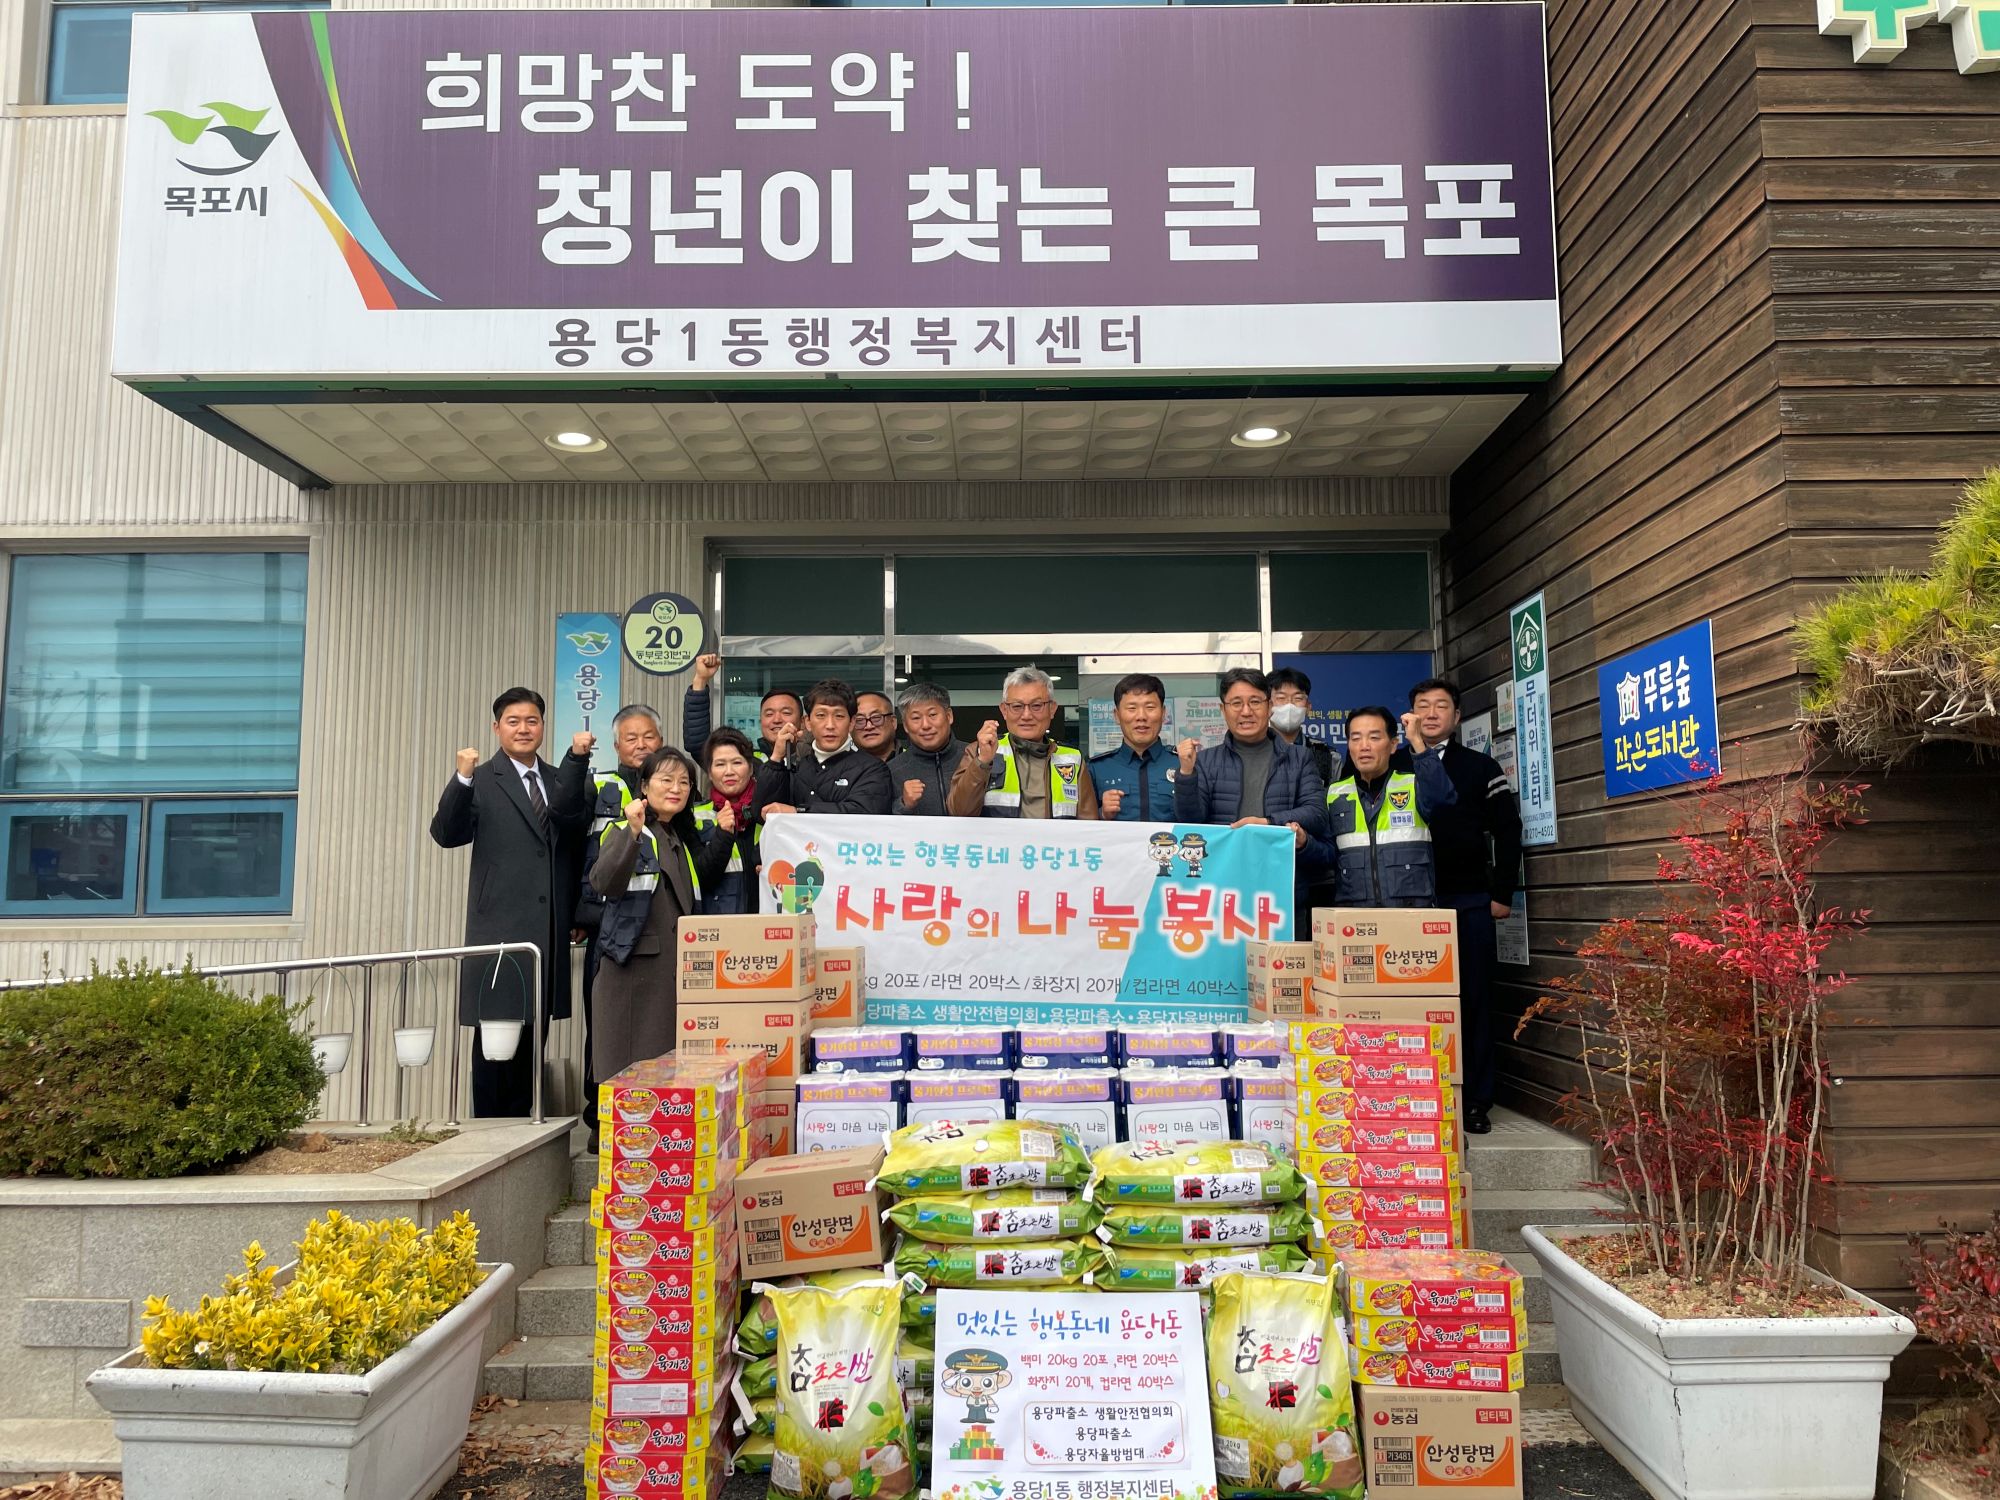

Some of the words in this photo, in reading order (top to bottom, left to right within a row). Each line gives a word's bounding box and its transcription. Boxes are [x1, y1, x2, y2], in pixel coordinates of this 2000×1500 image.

[421, 51, 696, 133] 희망찬
[736, 52, 914, 132] 도약
[956, 52, 970, 129] !
[163, 186, 269, 217] 목포시
[537, 167, 854, 265] 청년이
[907, 167, 1113, 262] 찾는
[1164, 166, 1261, 261] 큰
[1312, 165, 1520, 259] 목포
[645, 626, 683, 649] 20
[636, 651, 691, 660] 동부로31번길
[1643, 655, 1691, 713] 푸른숲
[1526, 680, 1538, 752] 무더위
[1614, 714, 1700, 774] 작은도서관
[1530, 760, 1542, 809] 쉼터
[837, 841, 906, 867] 멋있는
[915, 840, 1009, 869] 행복동네
[1019, 845, 1103, 871] 용당1동
[836, 883, 999, 946] 사랑의
[1017, 886, 1139, 950] 나눔
[1162, 888, 1281, 952] 봉사
[766, 929, 791, 939] 멀티팩
[1424, 923, 1449, 932] 멀티팩
[724, 956, 778, 971] 안성탕면
[1384, 950, 1438, 965] 안성탕면
[826, 961, 849, 971] 멀티팩
[815, 987, 837, 1000] 탕면
[866, 1003, 926, 1021] 당파출소
[767, 1016, 791, 1025] 멀티팩
[1358, 1035, 1384, 1047] 육개장
[1366, 1067, 1393, 1079] 육개장
[632, 1090, 650, 1098] BIG
[659, 1101, 692, 1116] 육개장
[1369, 1099, 1396, 1111] 육개장
[807, 1122, 836, 1133] 사랑의
[842, 1122, 861, 1133] 마음
[869, 1122, 888, 1132] 나눔
[1087, 1122, 1106, 1133] 나눔
[1138, 1122, 1168, 1134] 사랑의
[1174, 1122, 1194, 1133] 마음
[1200, 1121, 1219, 1131] 나눔
[1253, 1119, 1283, 1130] 사랑의
[660, 1136, 692, 1151] 육개장
[1366, 1131, 1393, 1144] 육개장
[658, 1171, 690, 1186] 육개장
[1373, 1165, 1400, 1178] 육개장
[836, 1182, 865, 1194] 멀티팩
[1376, 1198, 1403, 1211] 육개장
[650, 1207, 682, 1222] 육개장
[792, 1215, 853, 1238] 안성탕면
[1379, 1231, 1406, 1244] 육개장
[657, 1244, 690, 1259] 육개장
[656, 1282, 689, 1297] 육개장
[1429, 1291, 1458, 1306] 육개장
[657, 1318, 690, 1333] 육개장
[957, 1310, 1018, 1337] 멋있는
[1028, 1308, 1109, 1340] 행복동네
[1120, 1309, 1182, 1340] 용당1동
[1434, 1328, 1463, 1342] 육개장
[656, 1355, 689, 1371] 육개장
[1021, 1354, 1042, 1366] 백미
[1048, 1354, 1077, 1368] 20kg
[1083, 1354, 1108, 1366] 20포
[1143, 1353, 1179, 1366] 20박스
[1423, 1363, 1453, 1377] 육개장
[1027, 1376, 1059, 1390] 화장지
[1099, 1376, 1132, 1390] 컵라면
[1138, 1375, 1174, 1389] 40박스
[1032, 1406, 1088, 1419] 용당파출소
[1095, 1406, 1173, 1420] 생활안전협의회
[1478, 1410, 1510, 1422] 멀티팩
[651, 1430, 684, 1446] 육개장
[1075, 1427, 1132, 1440] 용당파출소
[1065, 1448, 1145, 1462] 용당자율방범대
[1427, 1444, 1495, 1463] 안성탕면
[646, 1469, 680, 1485] 육개장
[1012, 1481, 1071, 1500] 용당1동
[1077, 1479, 1175, 1499] 행정복지센터
